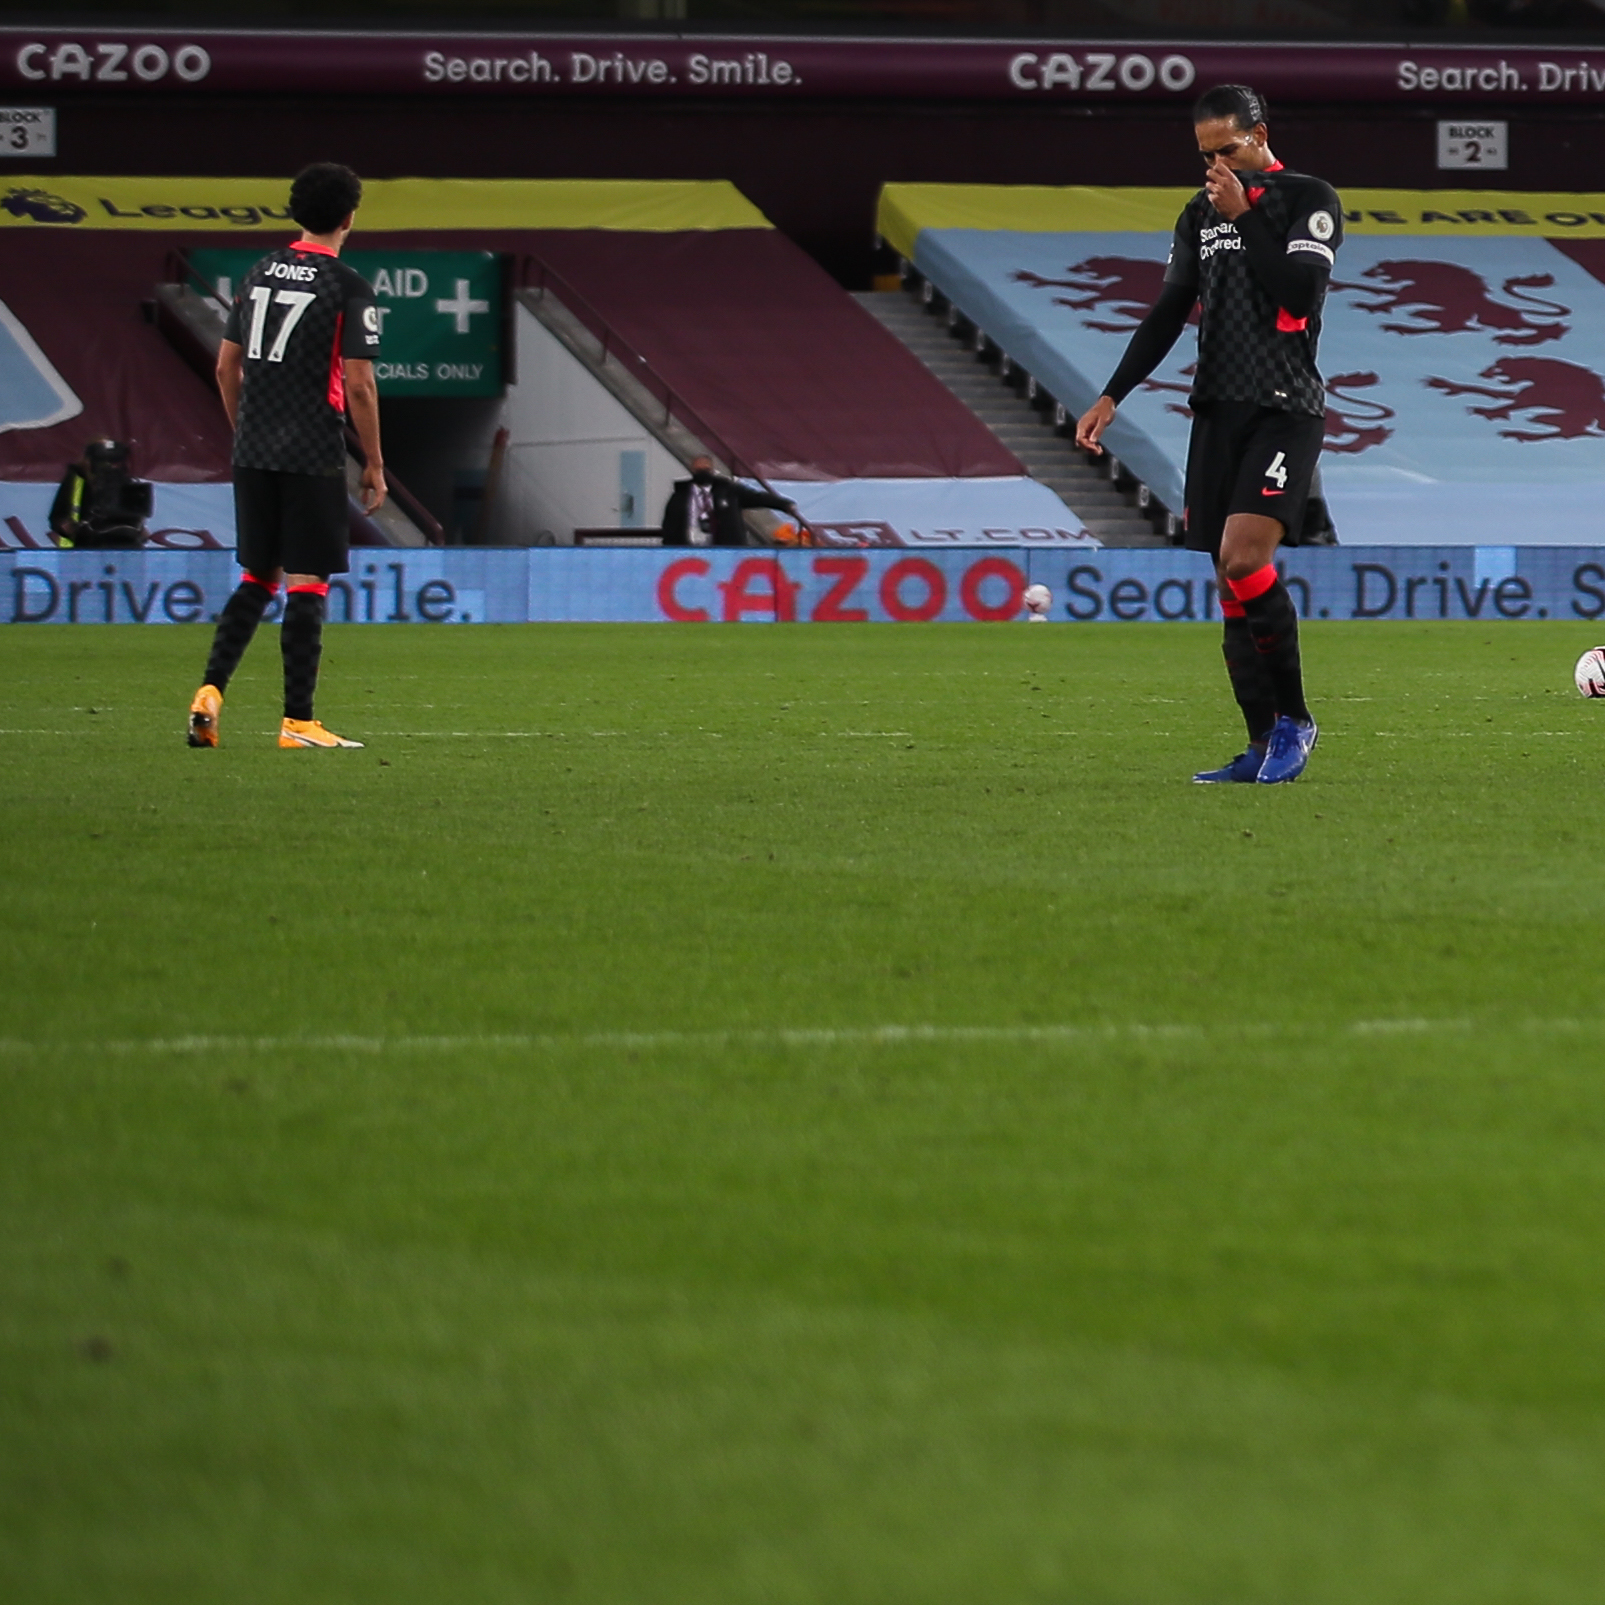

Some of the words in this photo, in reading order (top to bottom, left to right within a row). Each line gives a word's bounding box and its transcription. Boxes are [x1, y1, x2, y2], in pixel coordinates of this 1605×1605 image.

[16, 43, 212, 82] CAZOO
[424, 51, 561, 84] Search.
[571, 51, 676, 84] Drive.
[688, 52, 803, 86] Smile.
[1009, 52, 1196, 92] CAZOO
[1398, 61, 1528, 93] Search.
[11, 126, 28, 150] 3
[1449, 125, 1495, 140] BLOCK
[1464, 140, 1482, 163] 2
[99, 197, 294, 226] Leagu
[1420, 209, 1538, 225] ARE
[264, 261, 318, 283] JONES
[374, 268, 429, 298] AID
[247, 285, 317, 363] 17
[375, 363, 429, 380] CIALS
[437, 363, 484, 380] ONLY
[1265, 451, 1288, 488] 4
[12, 563, 219, 623] Drive.
[657, 557, 1028, 623] CAZOO
[1065, 563, 1330, 621] Searh.
[1351, 559, 1548, 620] Drive.
